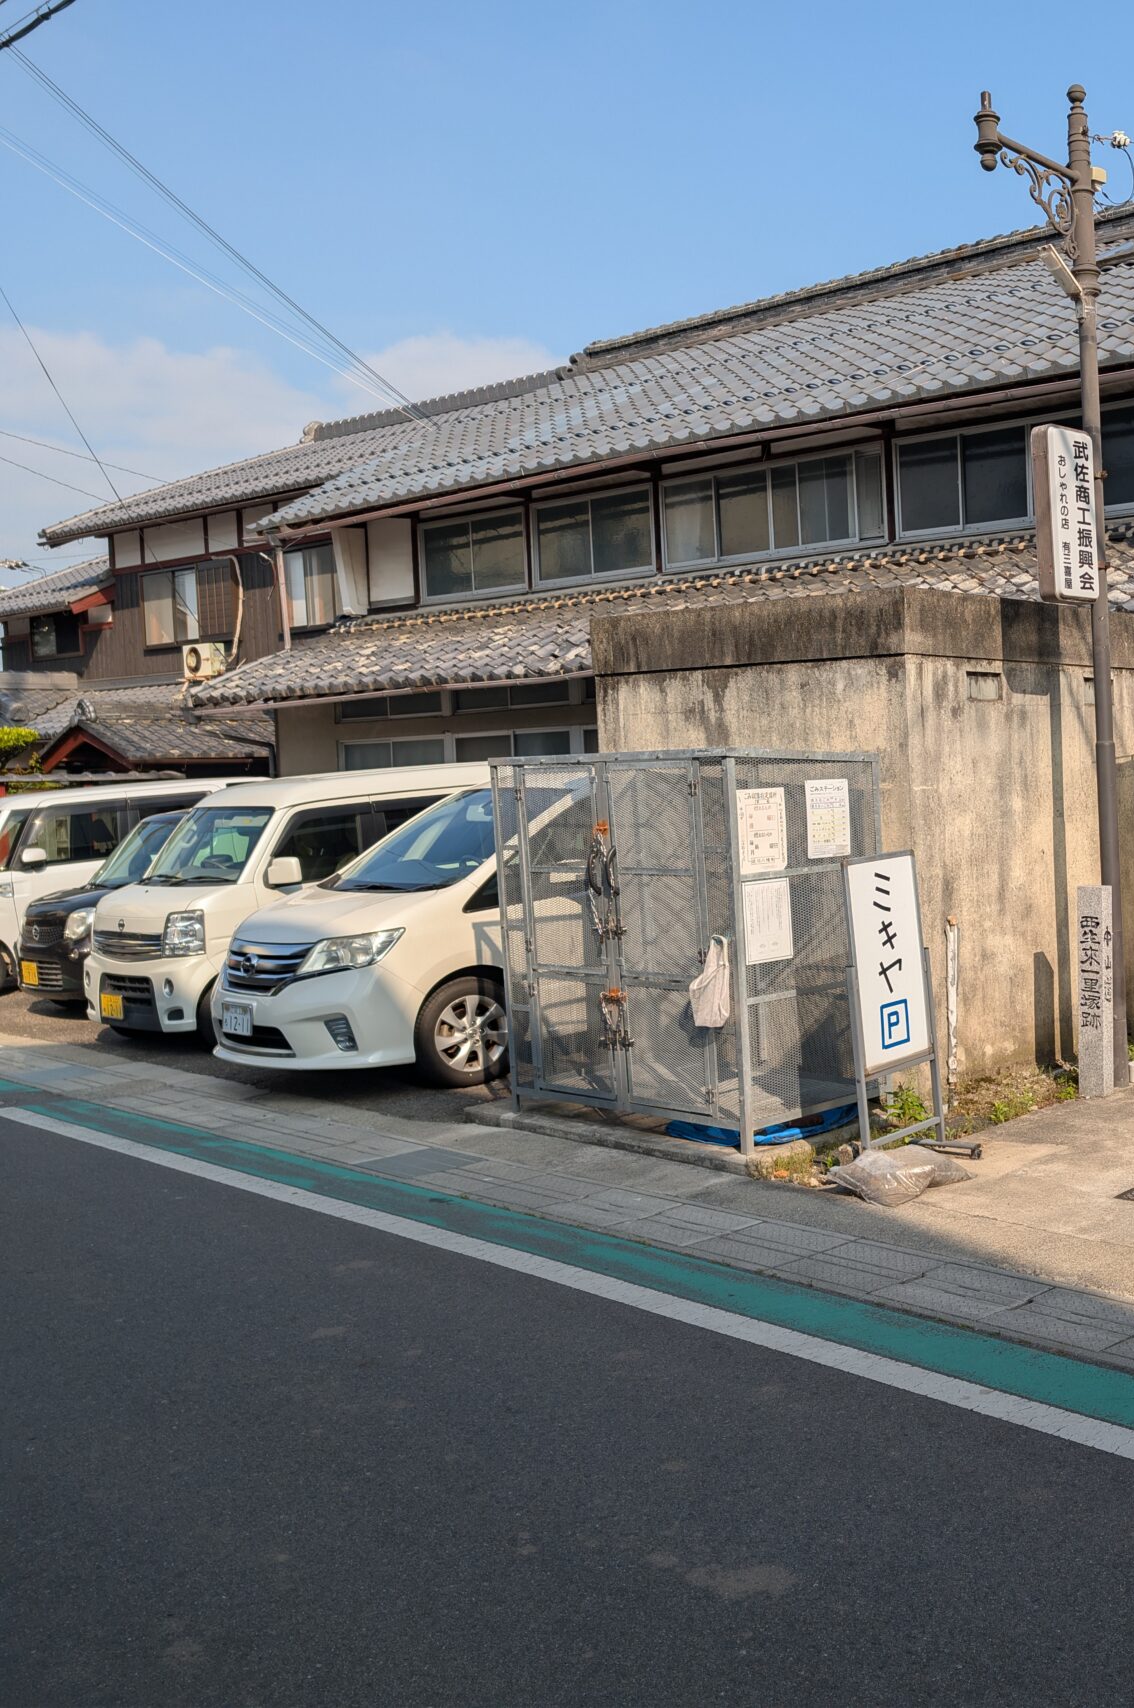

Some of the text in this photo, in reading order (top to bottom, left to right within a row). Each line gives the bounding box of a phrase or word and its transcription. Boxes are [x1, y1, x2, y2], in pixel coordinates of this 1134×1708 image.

[1057, 454, 1070, 530] おしゃれの店
[1072, 440, 1095, 592] 武佐商工振興会
[873, 872, 903, 993] ミキヤ
[888, 1010, 900, 1039] P
